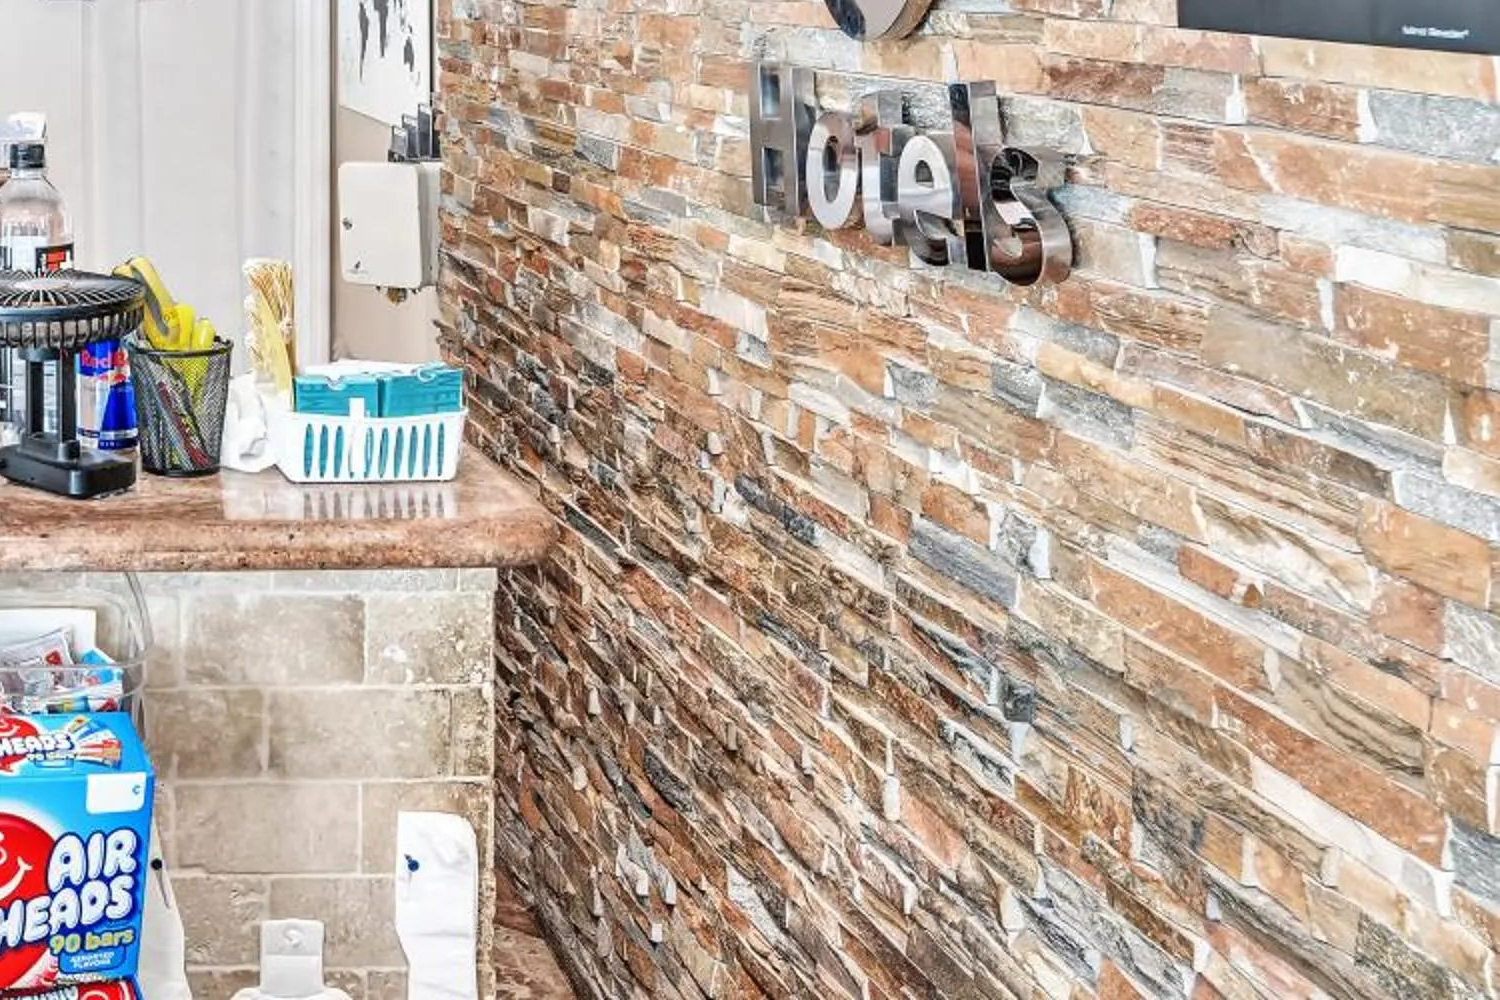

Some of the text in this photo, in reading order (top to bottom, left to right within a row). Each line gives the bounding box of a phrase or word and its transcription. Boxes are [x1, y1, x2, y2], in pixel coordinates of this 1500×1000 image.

[750, 61, 1073, 287] Hotels
[81, 349, 112, 369] Red
[48, 829, 137, 892] AIR
[51, 928, 134, 954] 90 bars
